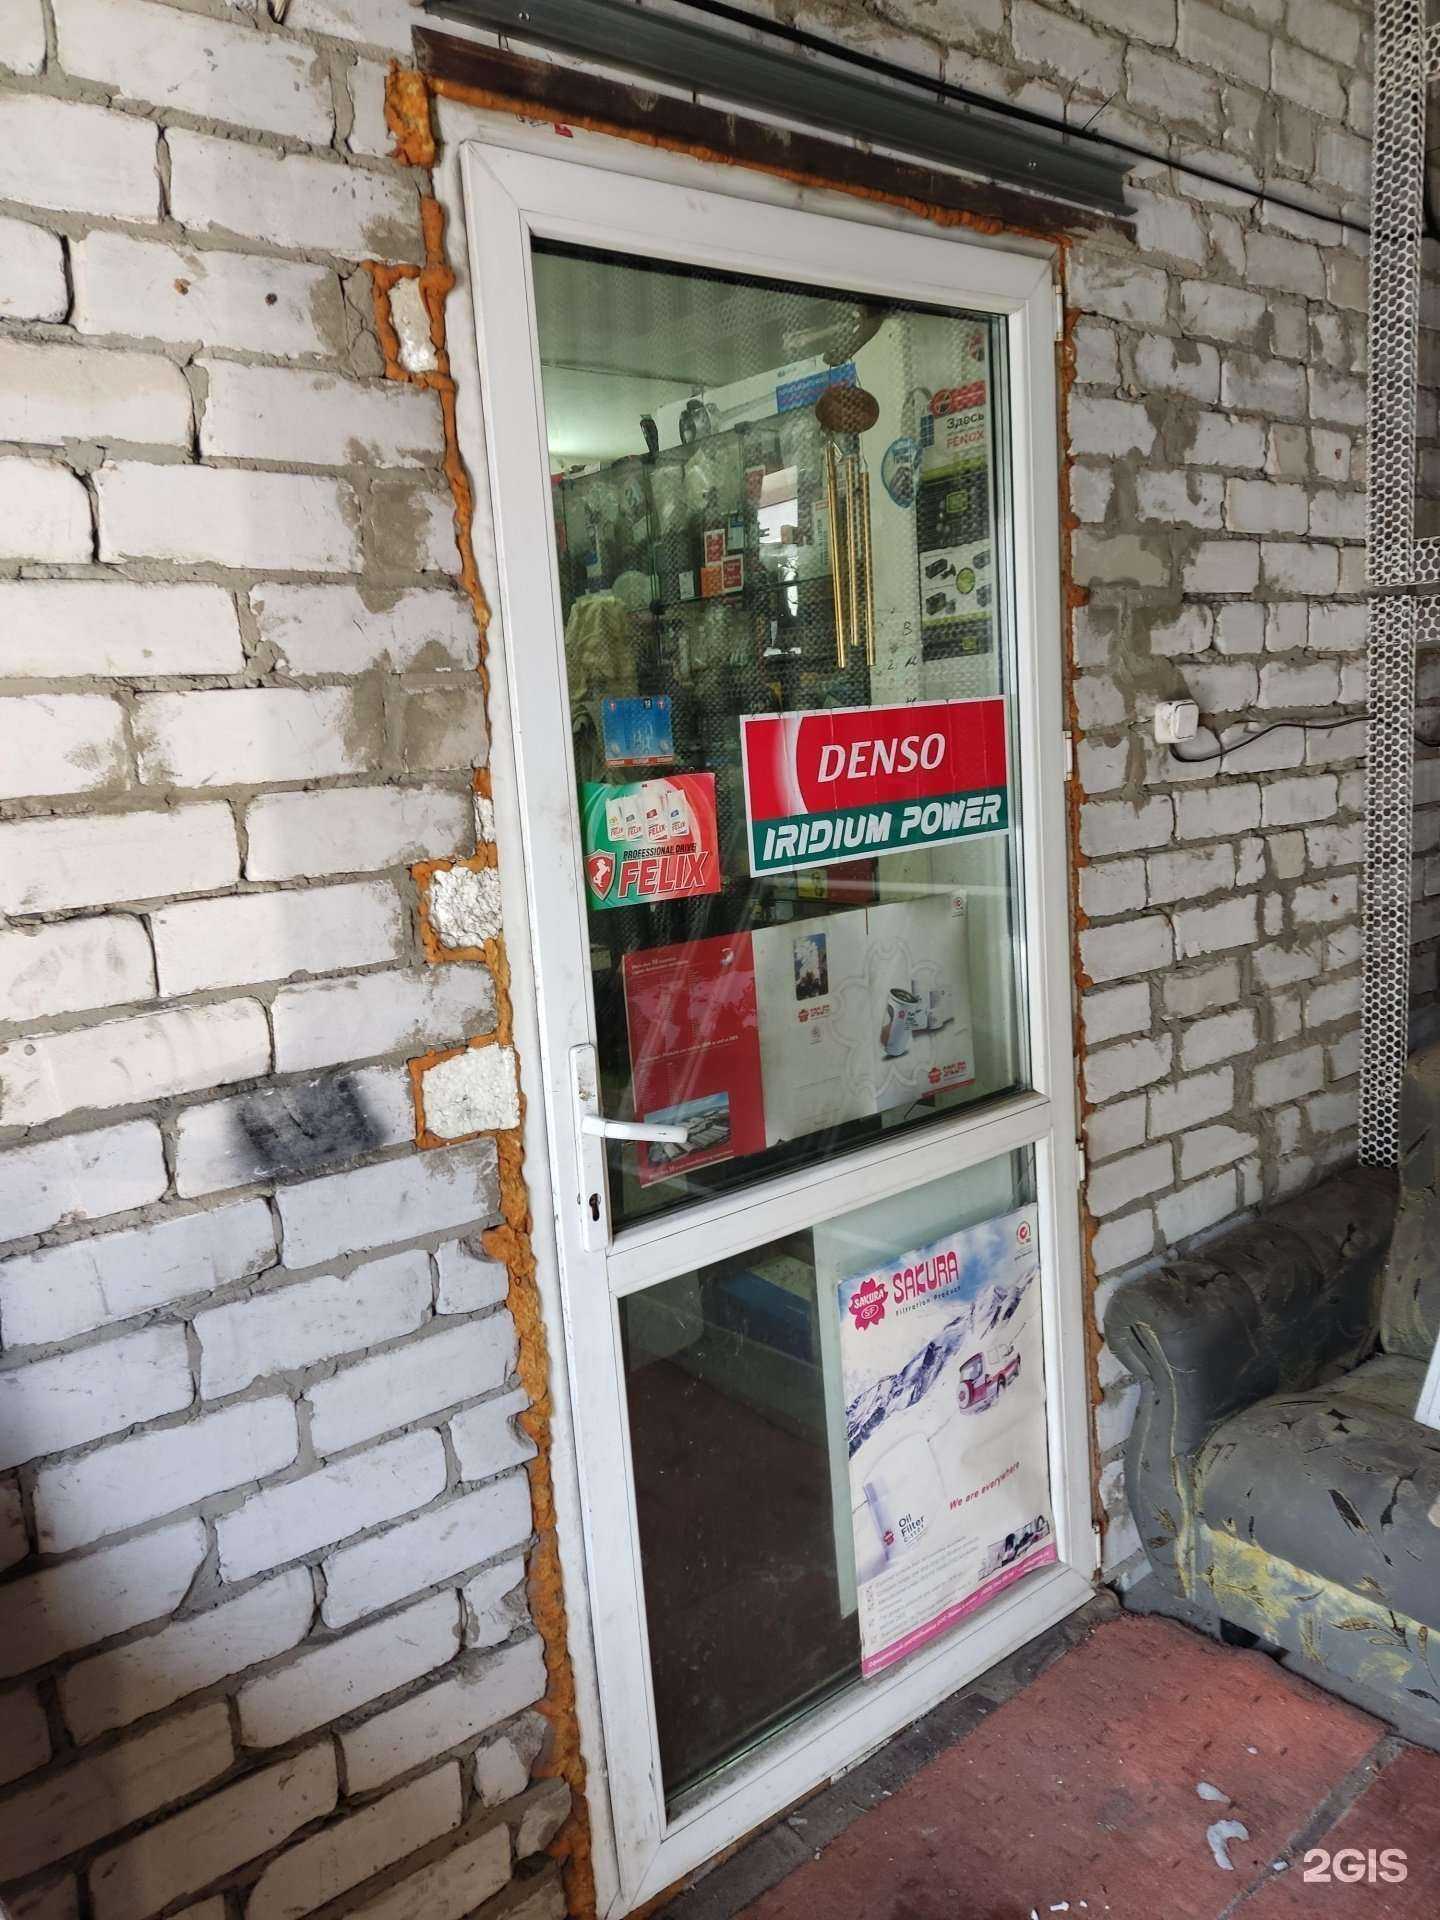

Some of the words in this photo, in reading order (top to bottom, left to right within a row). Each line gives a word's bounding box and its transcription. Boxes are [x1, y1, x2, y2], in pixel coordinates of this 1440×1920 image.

[947, 414, 984, 429] Здесь
[946, 431, 984, 448] FENOX
[817, 733, 946, 783] DENSO
[763, 811, 892, 861] IRIDIUM
[900, 794, 1002, 839] POWER
[623, 846, 675, 859] PROFESSIONAL
[618, 851, 708, 898] FELIX
[892, 1251, 959, 1304] SAKURA
[854, 1289, 885, 1310] SAKURA
[895, 1298, 931, 1317] Filtration
[933, 1285, 961, 1301] Product
[949, 1498, 963, 1511] We
[966, 1490, 979, 1503] are
[981, 1461, 1020, 1494] everywhere
[898, 1513, 912, 1528] Oil
[901, 1515, 925, 1537] Filter
